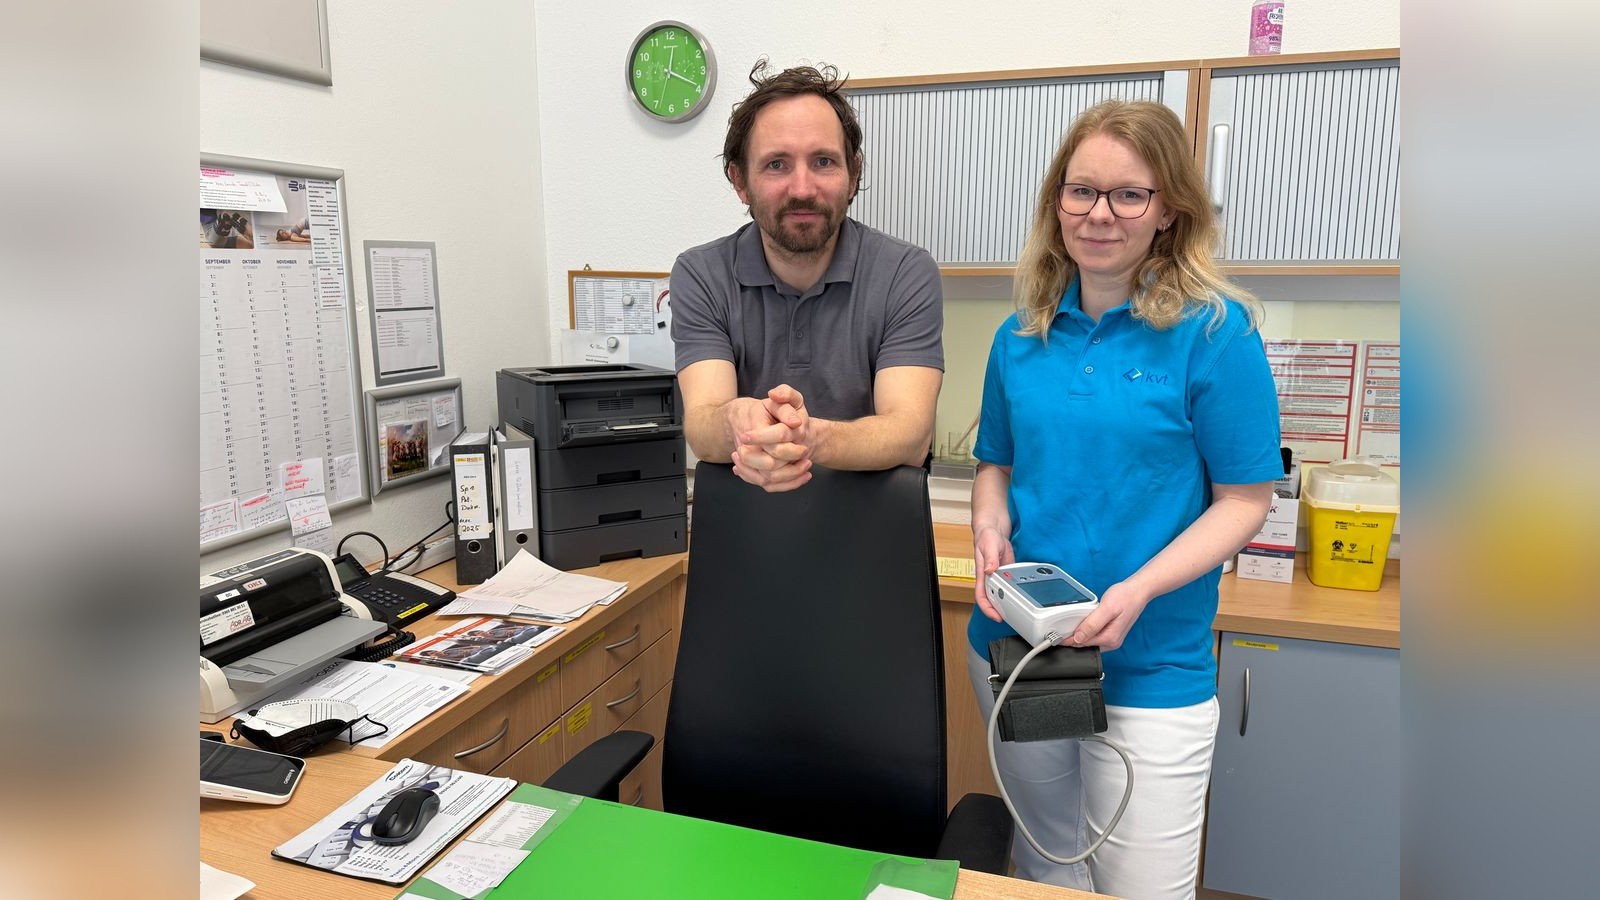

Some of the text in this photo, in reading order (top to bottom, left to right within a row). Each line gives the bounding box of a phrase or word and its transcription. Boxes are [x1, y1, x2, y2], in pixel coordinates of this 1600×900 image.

[665, 31, 675, 40] 12
[651, 38, 658, 47] 11
[640, 53, 649, 61] 10
[696, 50, 701, 58] 2
[636, 70, 641, 78] 9
[700, 66, 706, 75] 3
[642, 88, 647, 96] 8
[654, 100, 659, 109] 7
[684, 99, 690, 107] 5
[669, 104, 674, 113] 6
[1146, 371, 1168, 385] kvt
[248, 581, 262, 589] OKI
